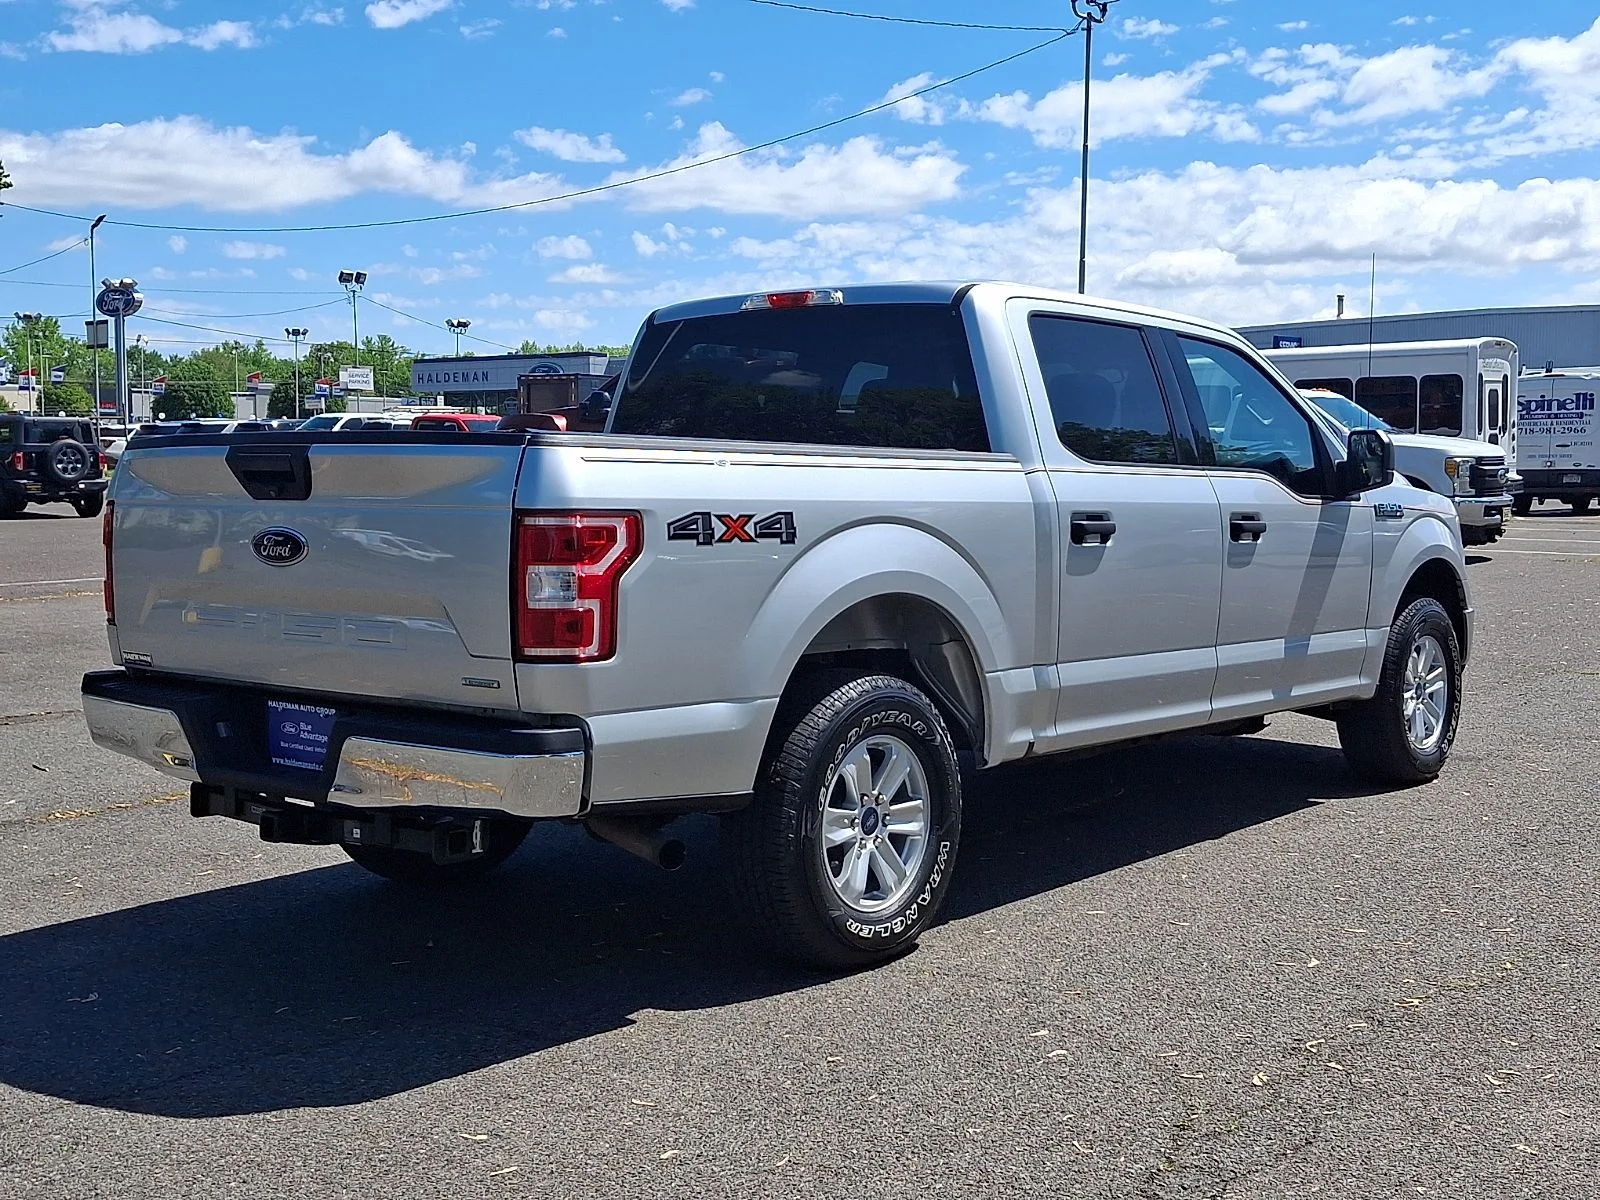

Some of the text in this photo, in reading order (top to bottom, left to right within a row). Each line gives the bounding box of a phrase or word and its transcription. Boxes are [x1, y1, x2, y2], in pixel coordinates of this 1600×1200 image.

[417, 370, 489, 385] HALDEMAN
[1517, 391, 1595, 413] Spinelli
[1518, 426, 1587, 436] 718-981-2966
[260, 534, 292, 557] Ford
[268, 699, 336, 716] HALDEMAN AUTO GROUP
[299, 721, 312, 731] Blue
[299, 731, 329, 743] Advantage
[818, 709, 929, 811] GOODYEAR
[845, 841, 950, 939] WRANGLER
